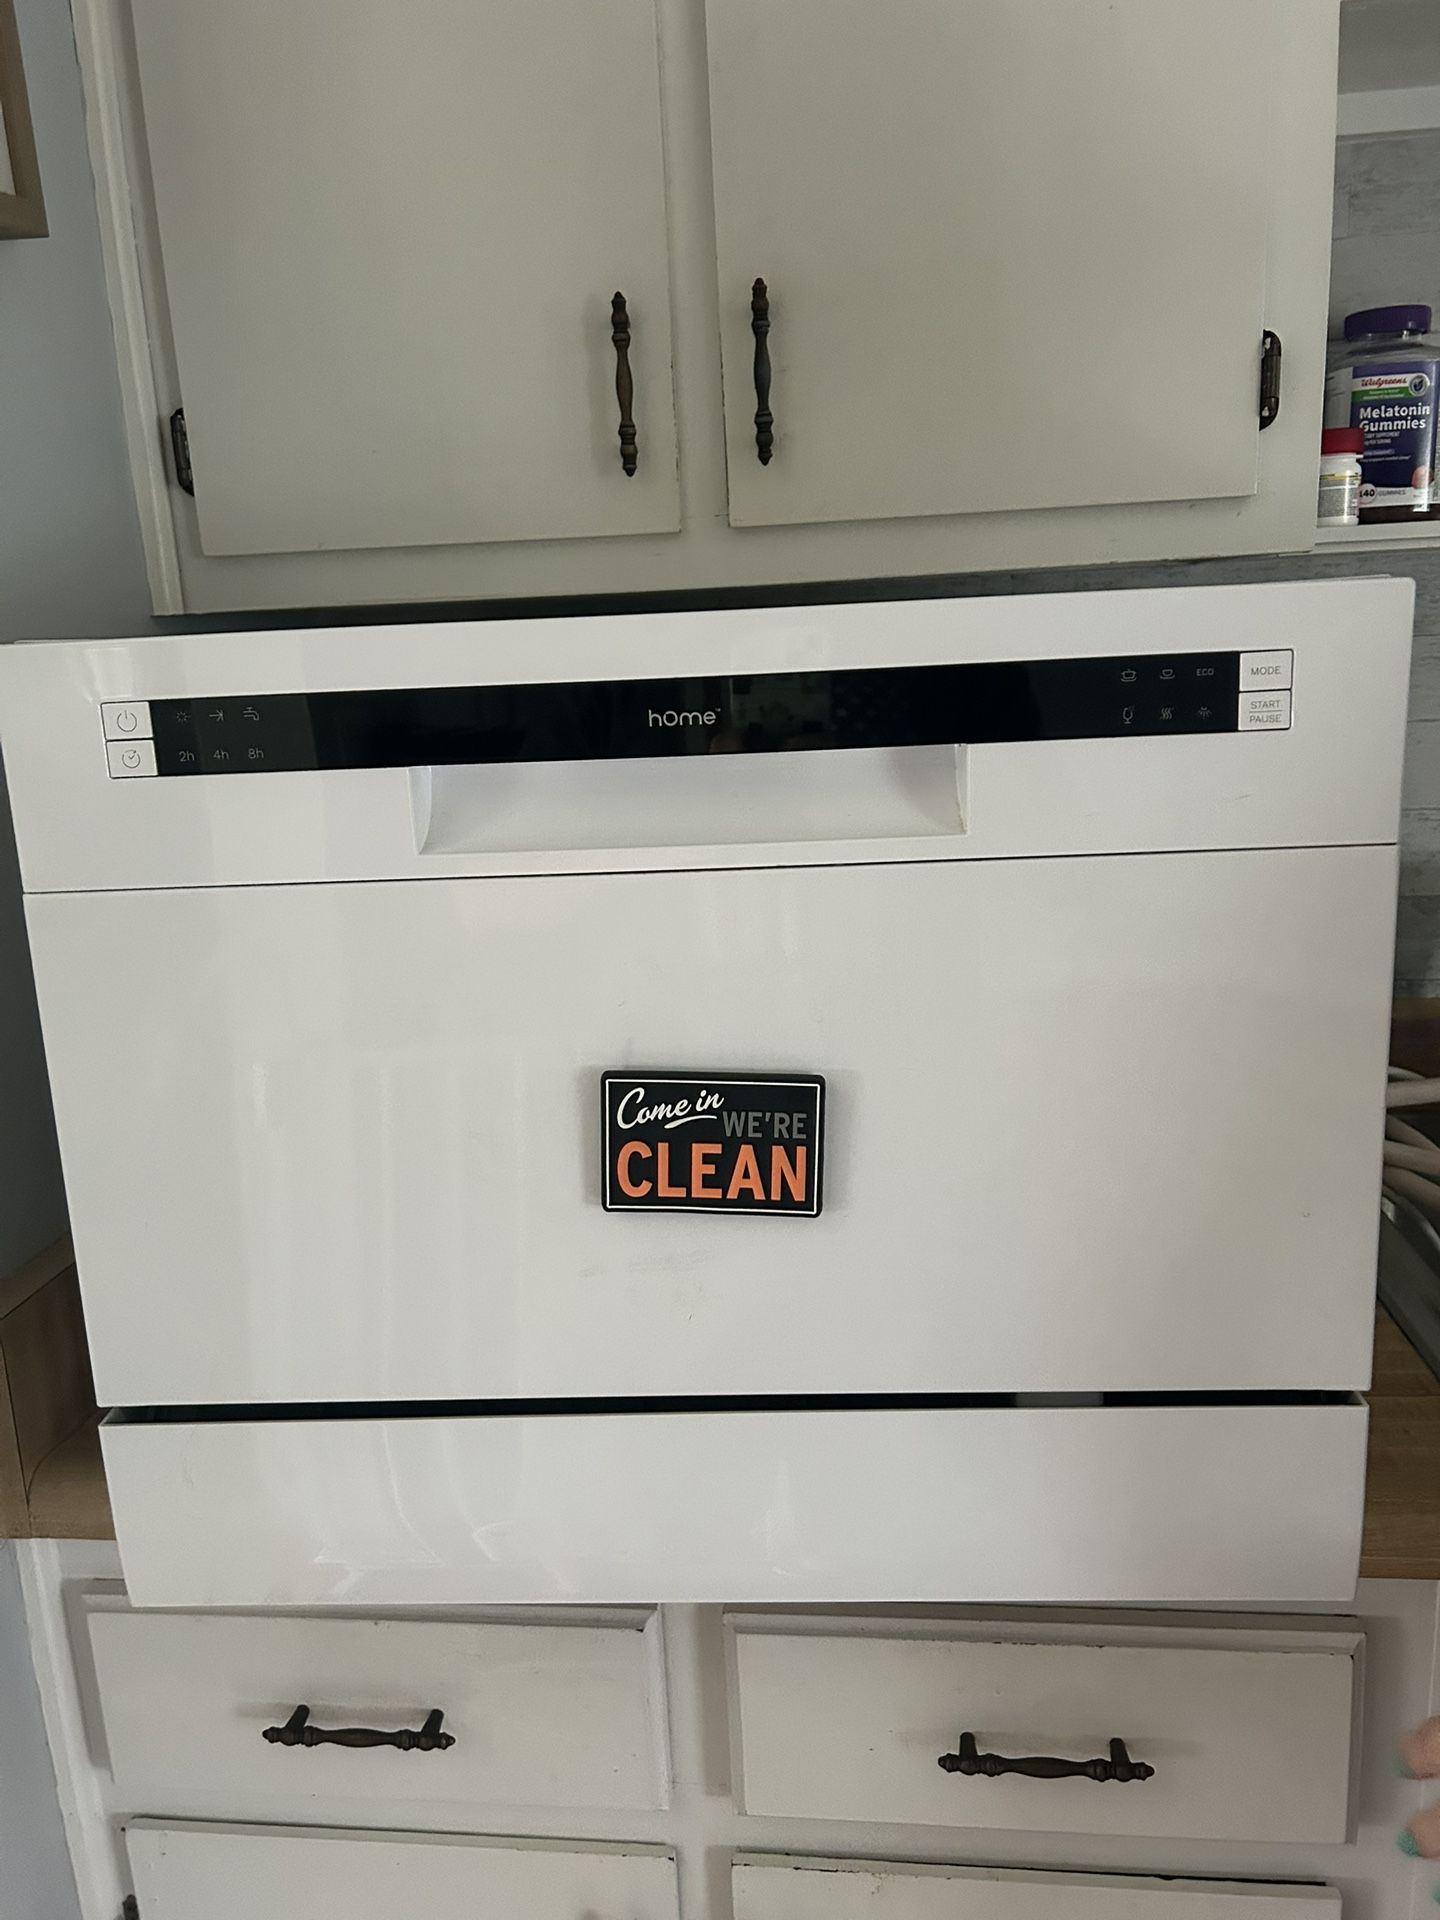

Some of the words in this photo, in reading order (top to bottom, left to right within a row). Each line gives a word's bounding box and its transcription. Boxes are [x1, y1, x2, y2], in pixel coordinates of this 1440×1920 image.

[1360, 376, 1407, 388] Walgreens
[1359, 402, 1431, 419] Melatonin
[1359, 417, 1427, 432] Gummies
[1359, 489, 1376, 498] 140
[1196, 668, 1215, 677] ECO
[1250, 665, 1282, 676] MODE
[1250, 700, 1281, 710] START
[1249, 713, 1282, 724] PAUSE
[178, 750, 195, 763] 2h
[212, 749, 230, 761] 4h
[247, 748, 265, 760] 8h
[616, 1086, 692, 1130] Come
[695, 1089, 725, 1110] in
[722, 1110, 808, 1139] WE'RE
[616, 1140, 808, 1202] CLEAN
